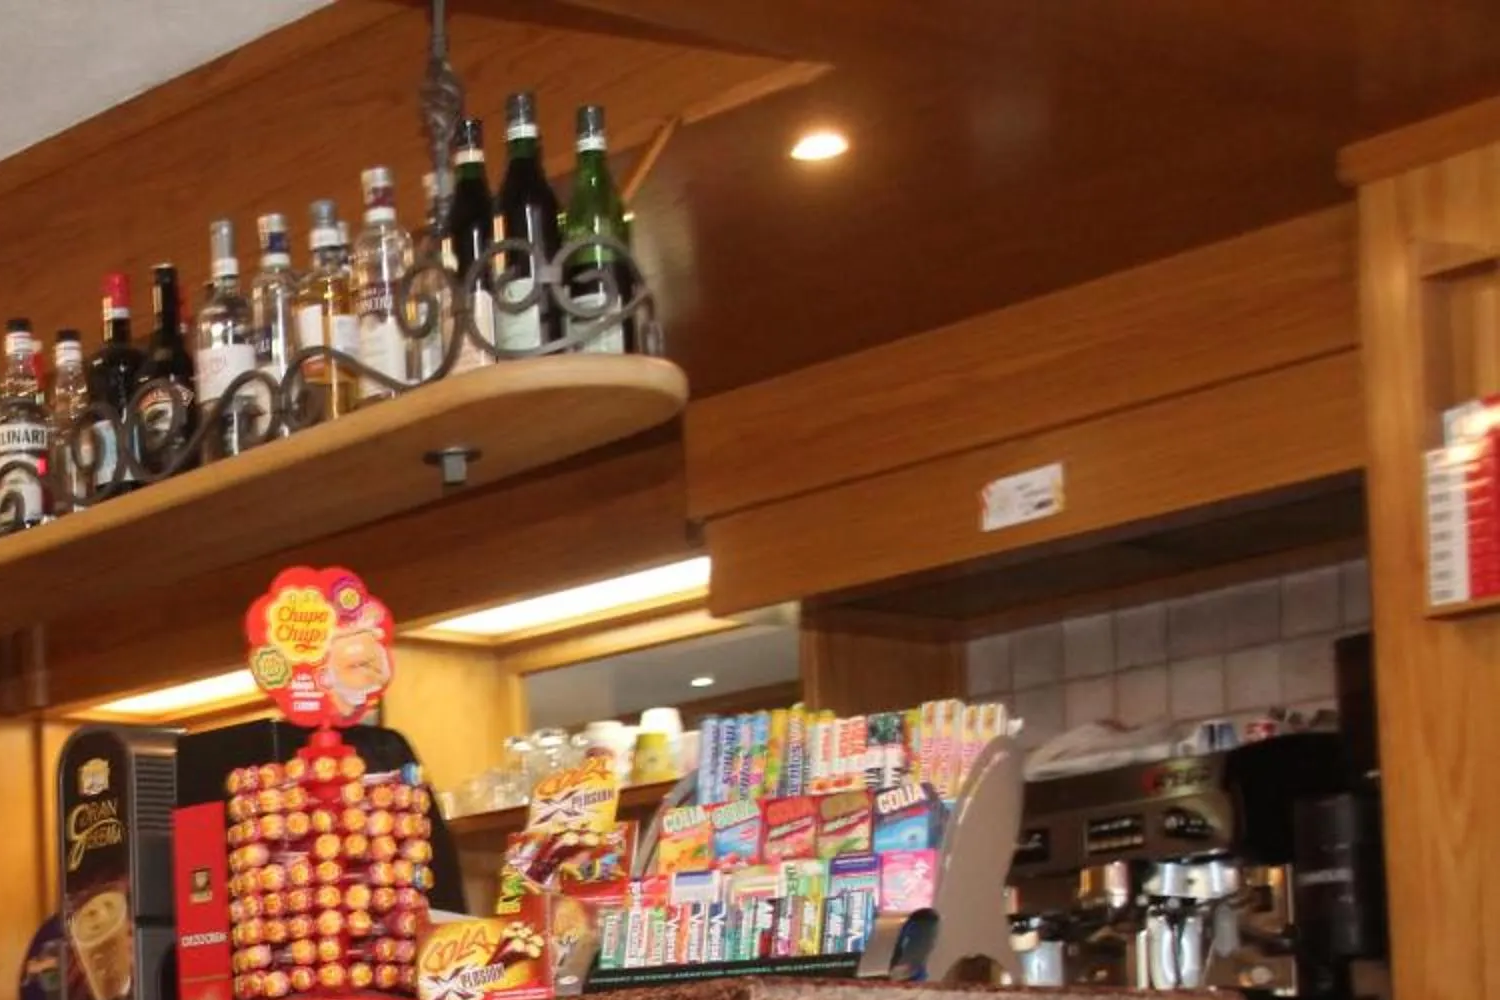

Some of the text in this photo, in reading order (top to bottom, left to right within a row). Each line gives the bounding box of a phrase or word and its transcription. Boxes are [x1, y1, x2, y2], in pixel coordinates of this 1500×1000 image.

[277, 605, 329, 625] Chupa
[275, 624, 328, 646] Chups
[423, 924, 498, 974] COLA
